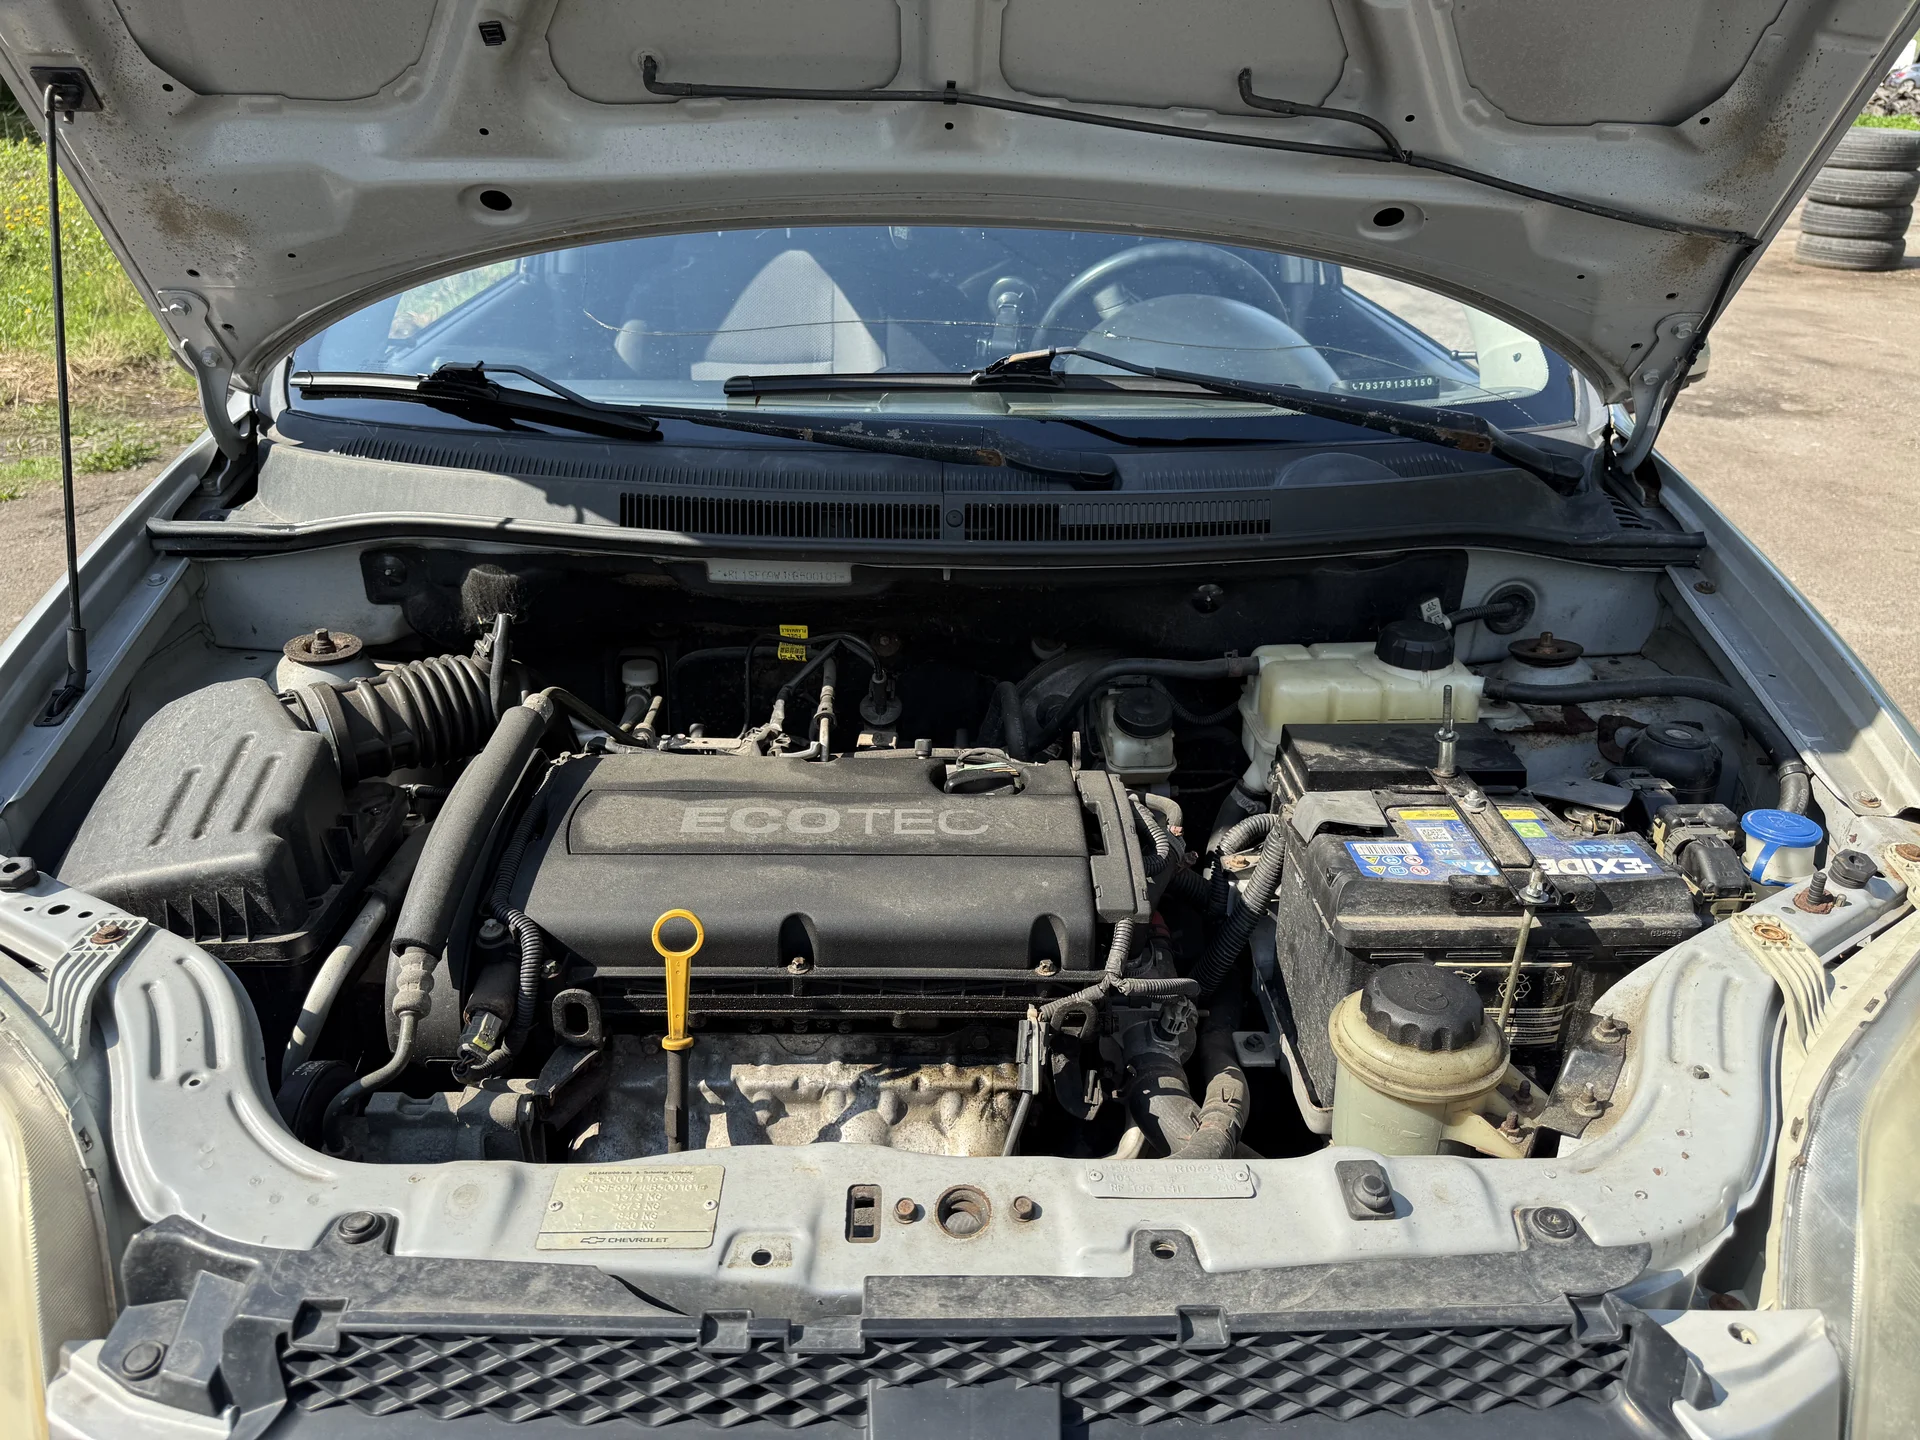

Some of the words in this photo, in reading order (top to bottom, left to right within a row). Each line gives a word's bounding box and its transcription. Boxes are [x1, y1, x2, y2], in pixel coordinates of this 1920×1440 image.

[1359, 377, 1433, 390] 79379138150
[679, 807, 989, 835] ECOTEC
[1433, 848, 1461, 856] 540
[1569, 844, 1635, 854] Excell
[1536, 858, 1652, 875] EXIDE
